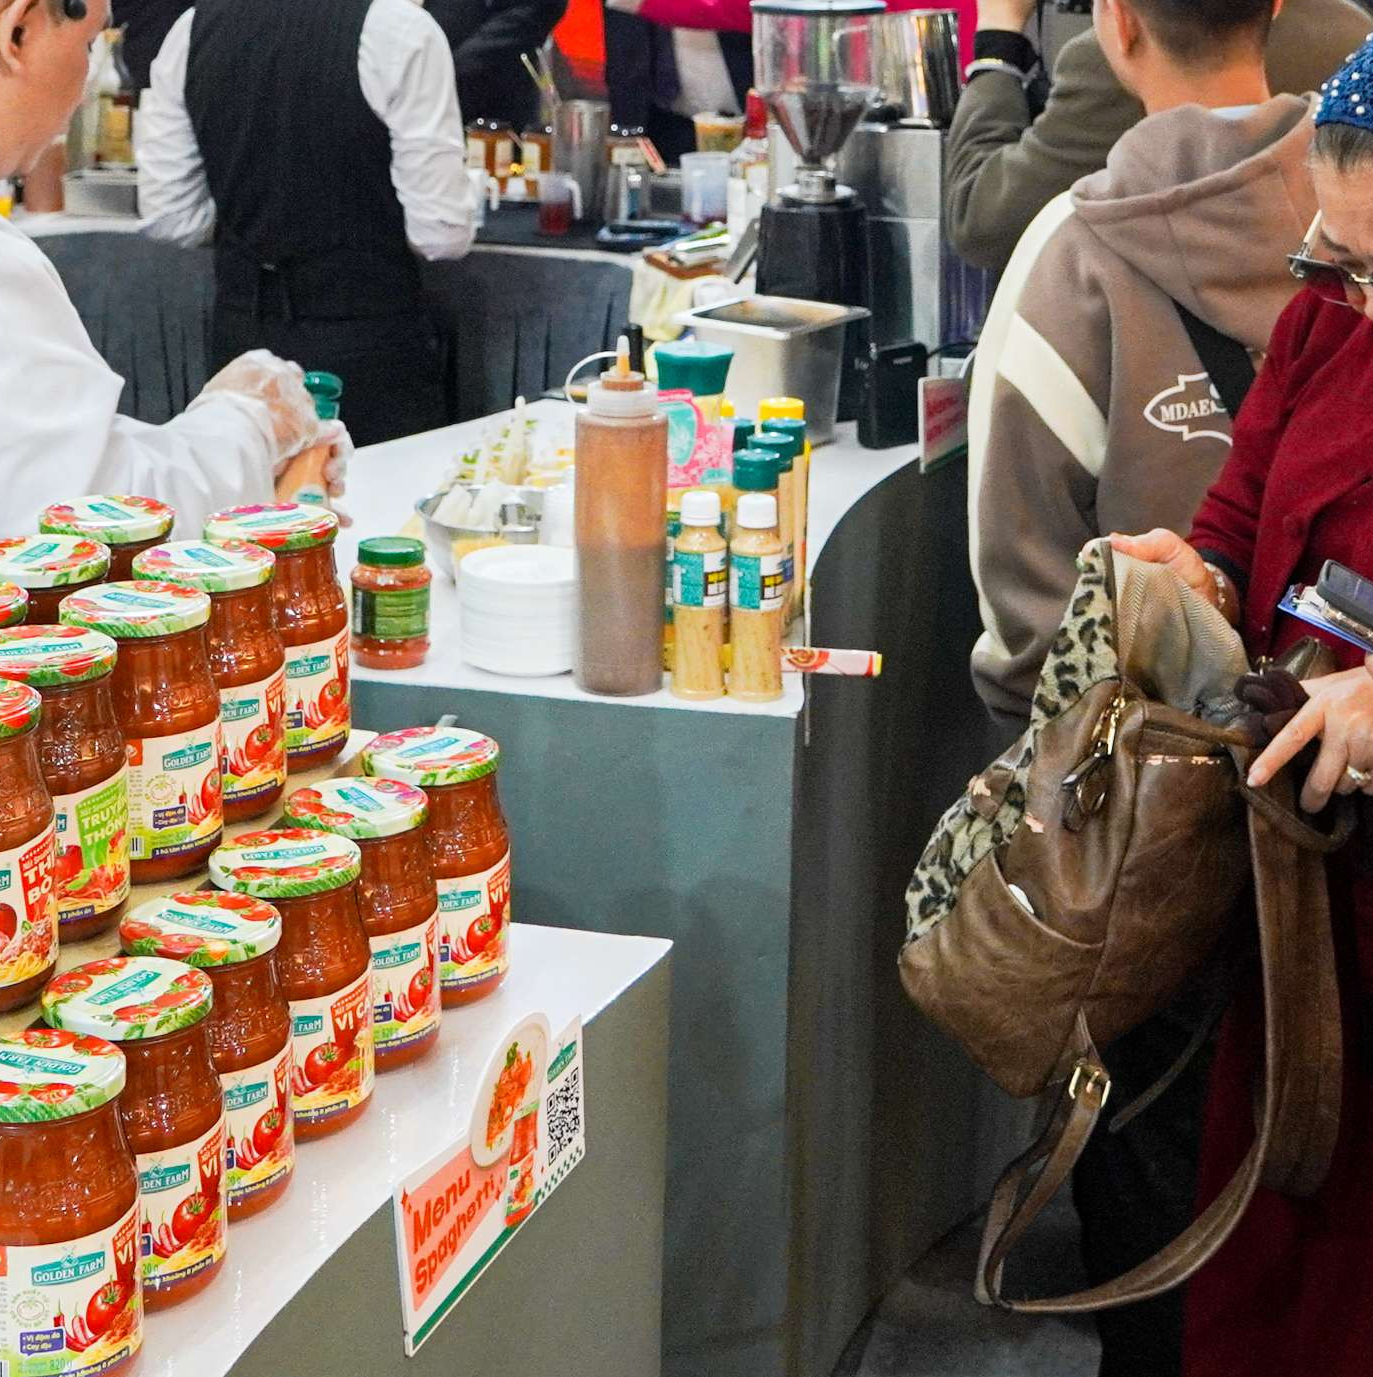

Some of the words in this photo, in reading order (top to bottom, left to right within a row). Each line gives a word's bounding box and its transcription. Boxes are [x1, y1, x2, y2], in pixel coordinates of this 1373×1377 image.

[27, 876, 53, 905] BÒ
[298, 1019, 323, 1033] FARM
[35, 1059, 83, 1074] GOLDEN
[246, 1086, 268, 1101] FARM
[165, 1168, 190, 1186] FARM
[412, 1168, 471, 1255] Menu
[414, 1174, 495, 1295] Spaghetti
[33, 1268, 75, 1284] GOLDEN
[78, 1255, 105, 1275] FARM
